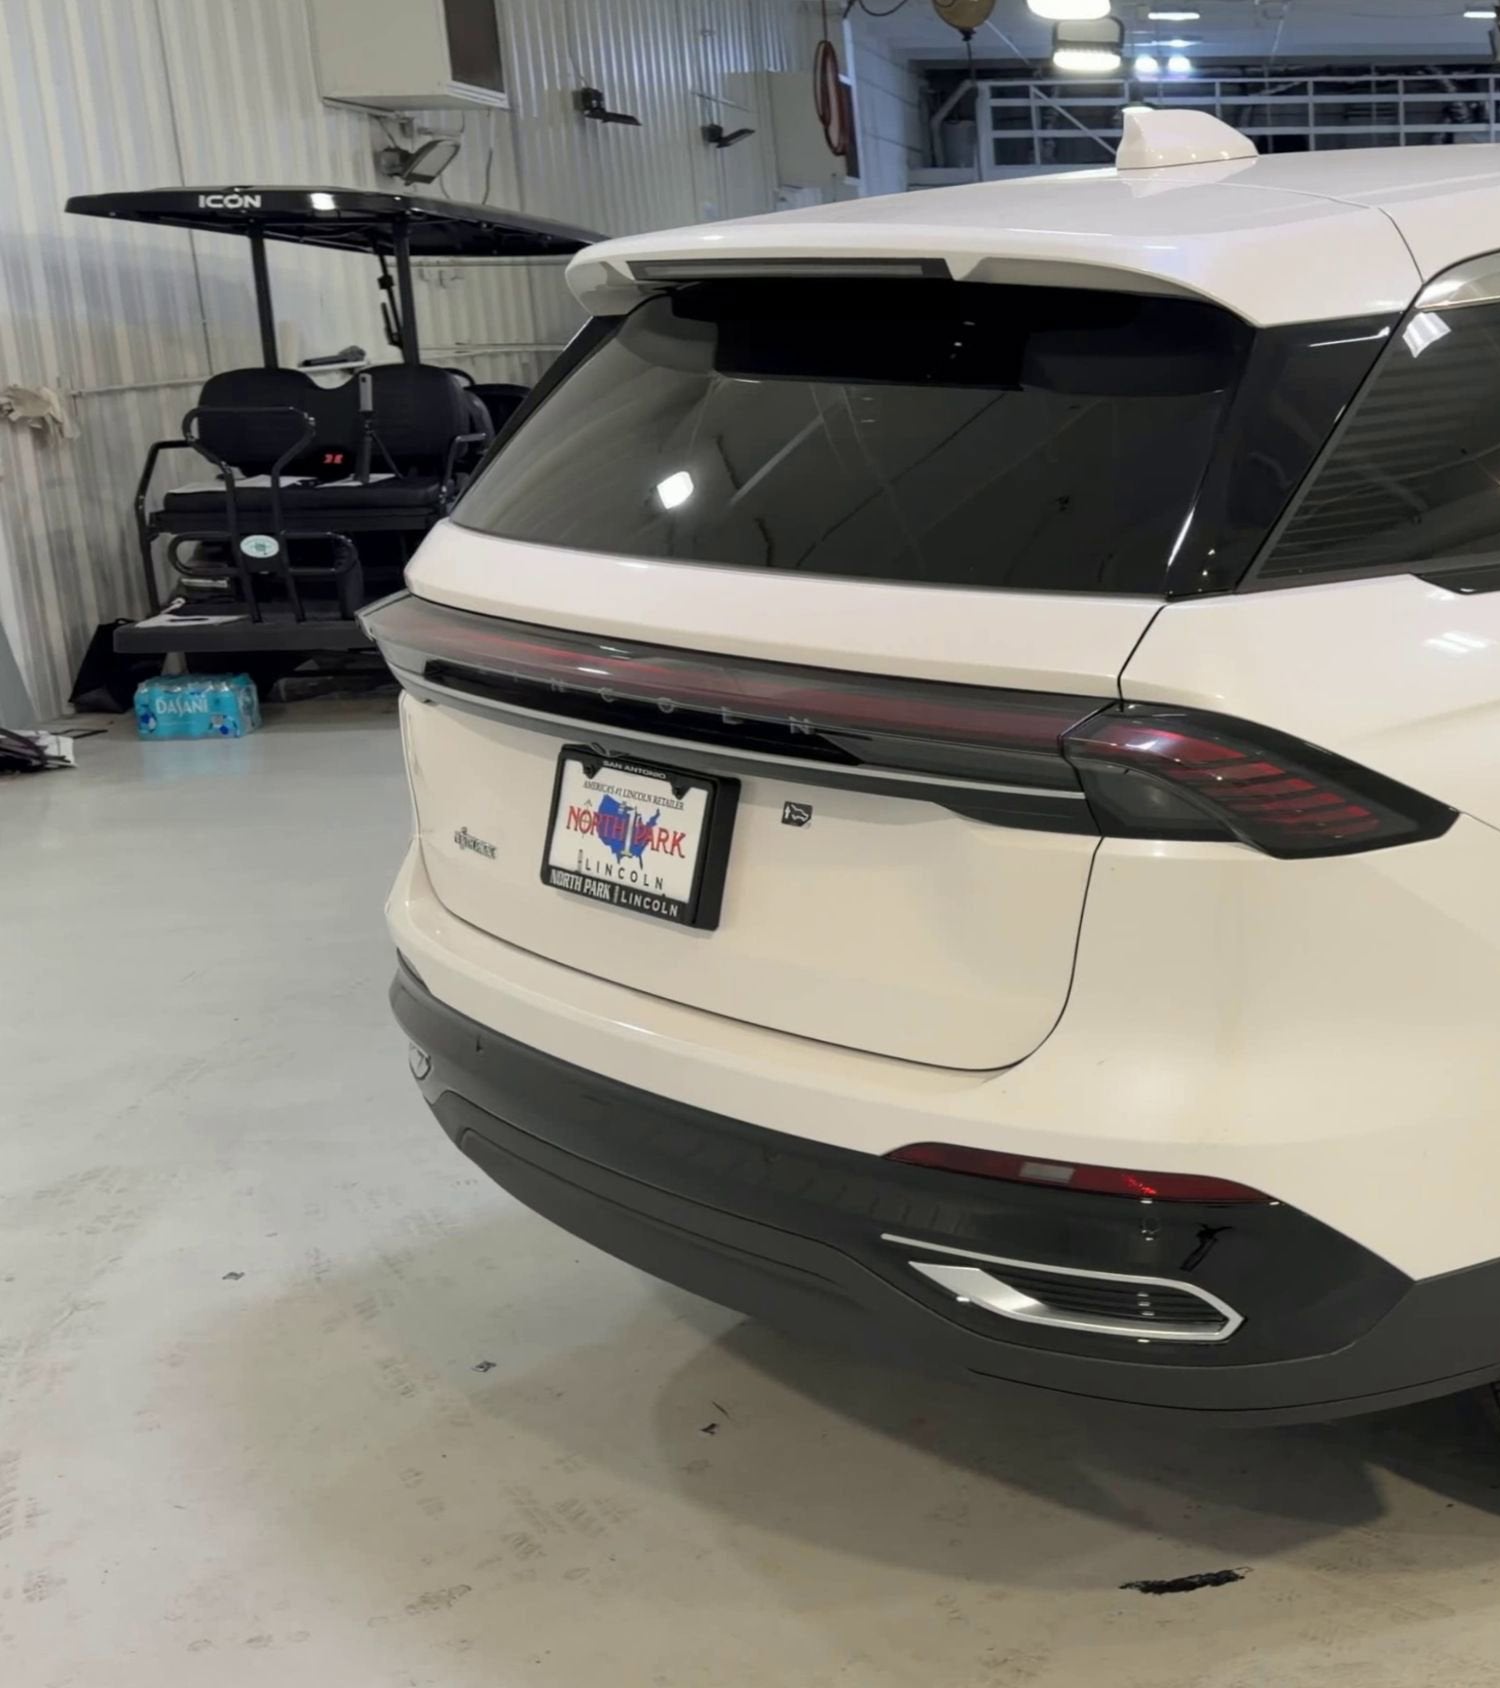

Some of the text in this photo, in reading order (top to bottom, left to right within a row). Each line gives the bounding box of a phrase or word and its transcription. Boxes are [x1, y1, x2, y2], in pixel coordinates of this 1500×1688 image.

[199, 194, 262, 209] ICON
[156, 697, 209, 717] DASANI
[476, 668, 816, 736] INCOLN
[602, 760, 667, 779] SAN ANTONIO
[622, 788, 652, 803] LINCOLN
[652, 795, 685, 811] RETAILER
[566, 805, 687, 859] NORTH PARK
[585, 858, 664, 890] LINCOLN
[549, 868, 679, 917] NORTH PARK LINCOLN
